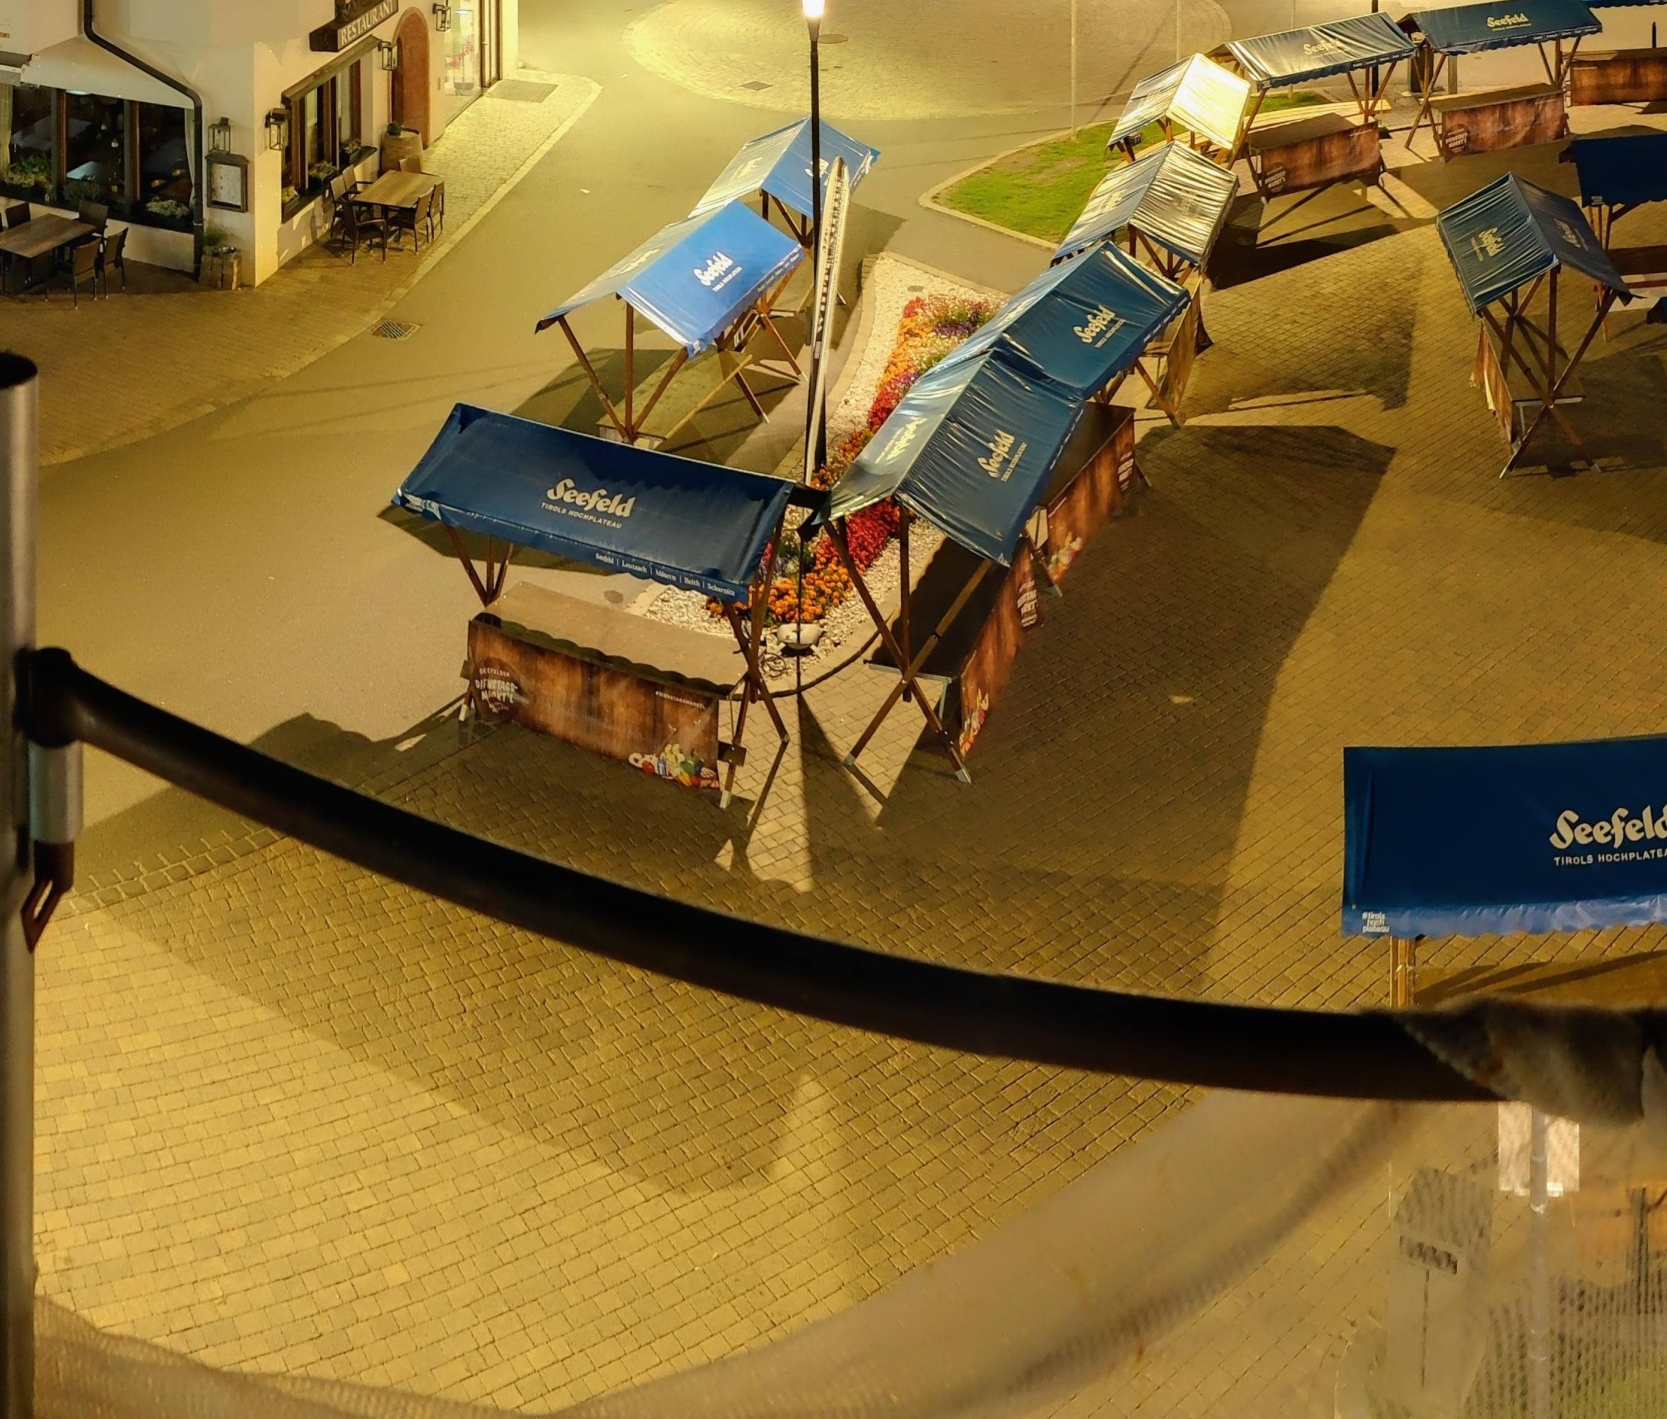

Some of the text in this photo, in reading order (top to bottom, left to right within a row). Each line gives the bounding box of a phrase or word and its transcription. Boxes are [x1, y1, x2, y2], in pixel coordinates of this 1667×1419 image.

[1487, 12, 1529, 28] Seefeld
[694, 251, 733, 287] Seefeld
[1073, 303, 1117, 344] Seefeld
[978, 428, 1016, 479] Seefeld
[547, 477, 636, 518] Seefeld
[541, 502, 623, 530] TIROLS HOCHPLATEAU
[1553, 854, 1594, 867] TIROLS
